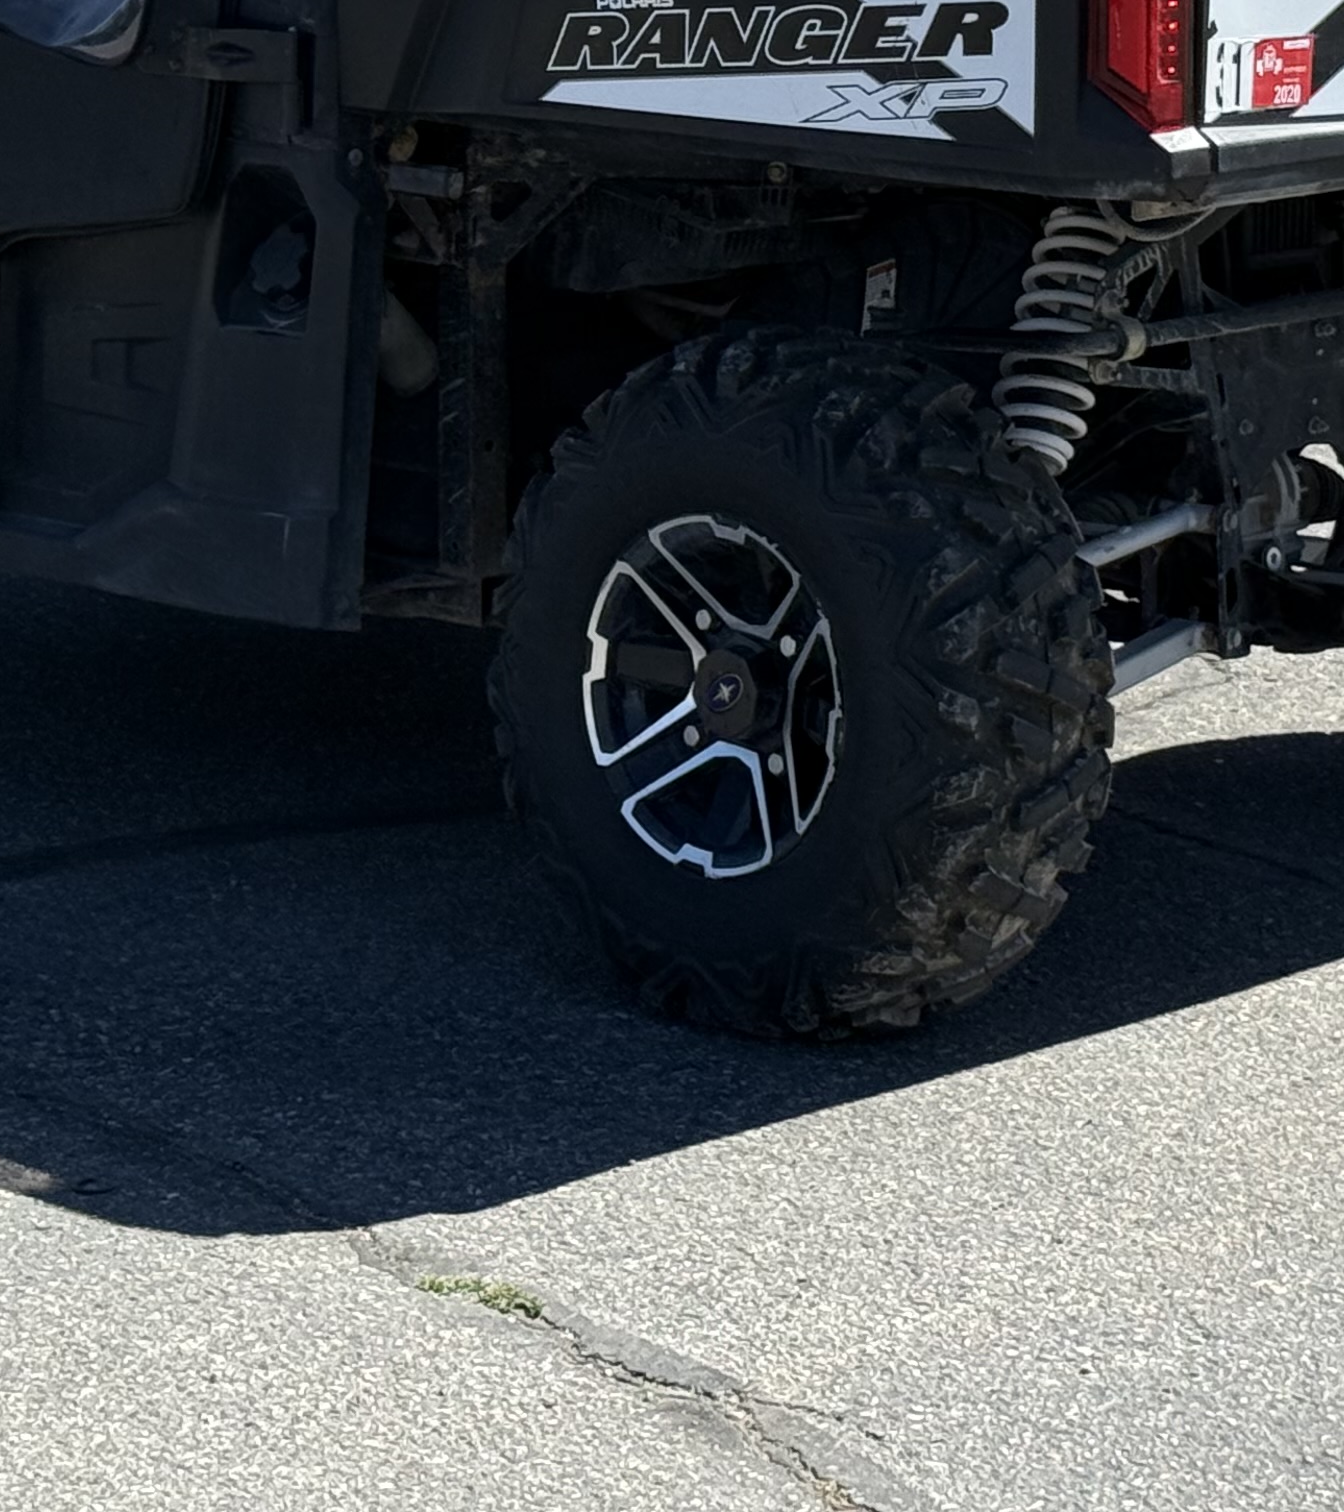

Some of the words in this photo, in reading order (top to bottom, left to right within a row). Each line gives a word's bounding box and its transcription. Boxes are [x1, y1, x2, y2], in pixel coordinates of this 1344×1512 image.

[545, 1, 1009, 72] RANGER
[798, 77, 1008, 124] XP
[1273, 83, 1302, 105] 2020
